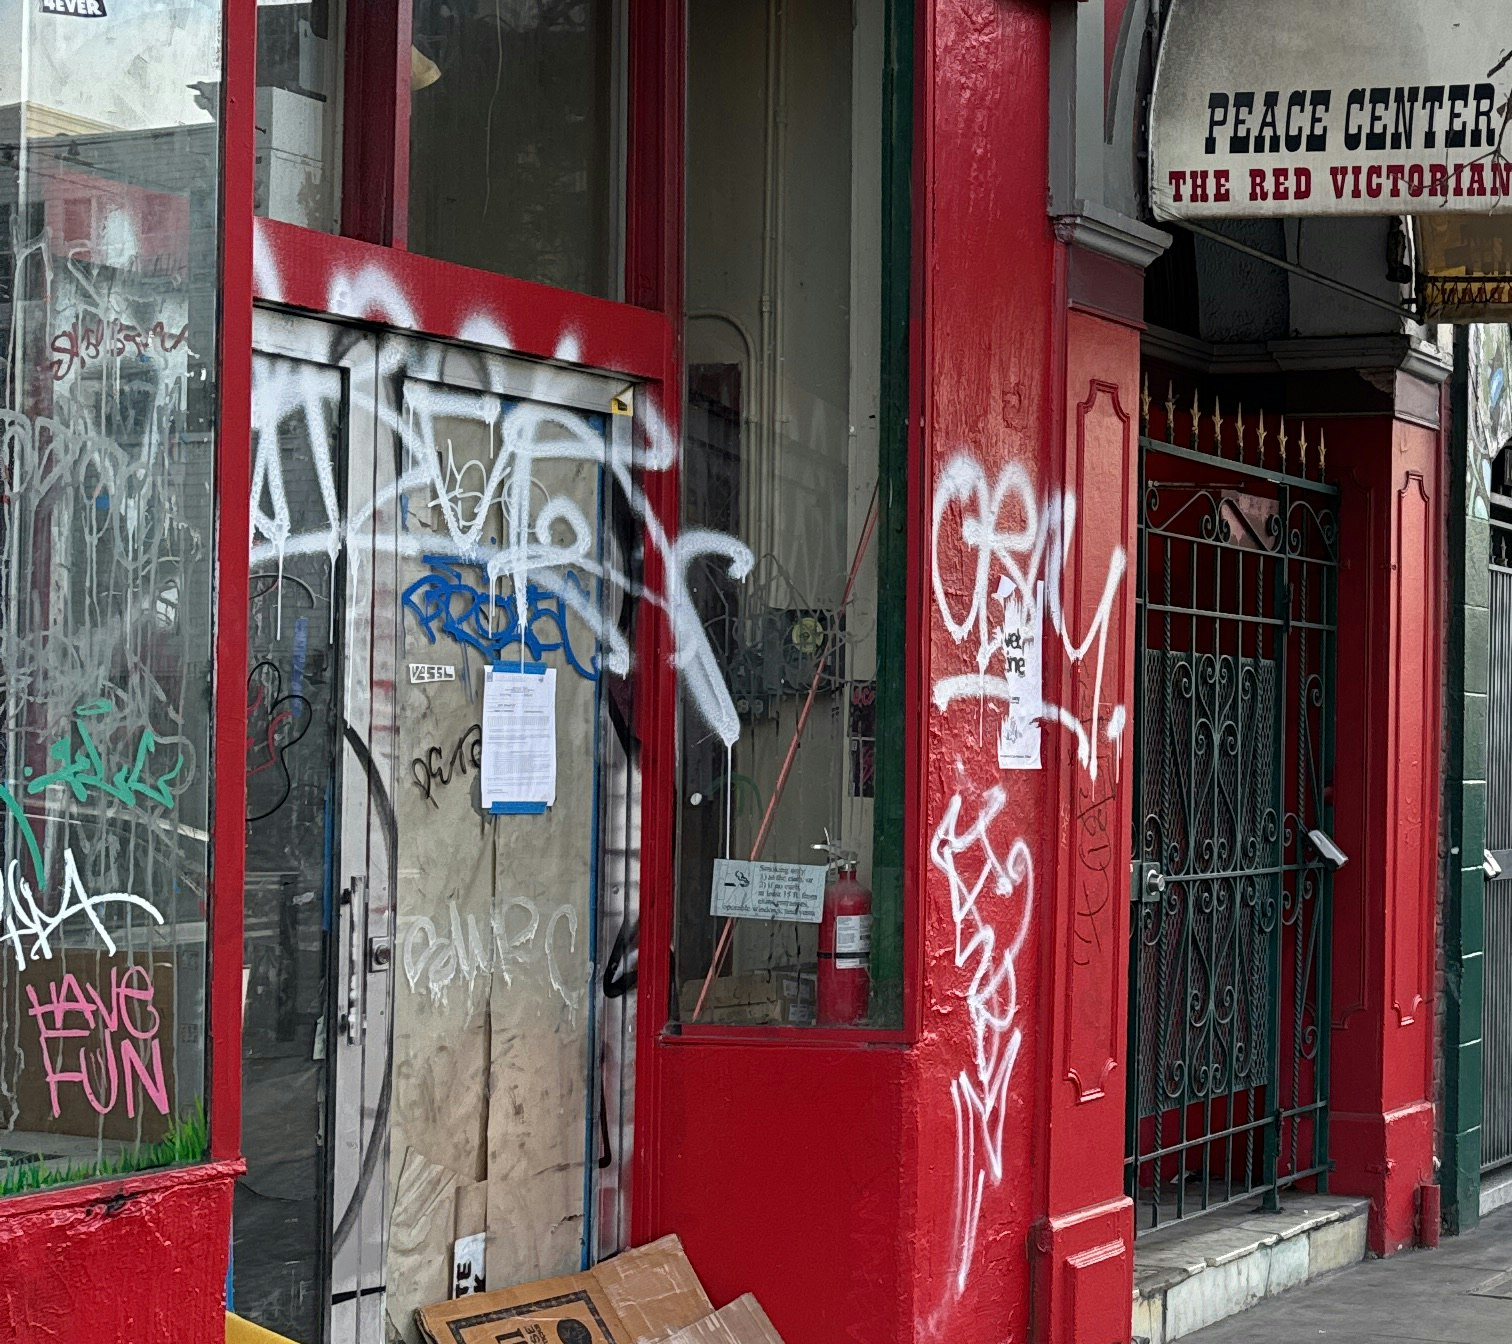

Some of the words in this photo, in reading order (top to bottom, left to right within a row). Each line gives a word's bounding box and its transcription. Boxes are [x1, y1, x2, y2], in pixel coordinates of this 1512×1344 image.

[1204, 90, 1332, 154] PEACE
[1344, 83, 1497, 151] CENTER
[1168, 169, 1230, 203] THE
[1249, 166, 1312, 201] RED
[39, 1029, 171, 1119] FUN
